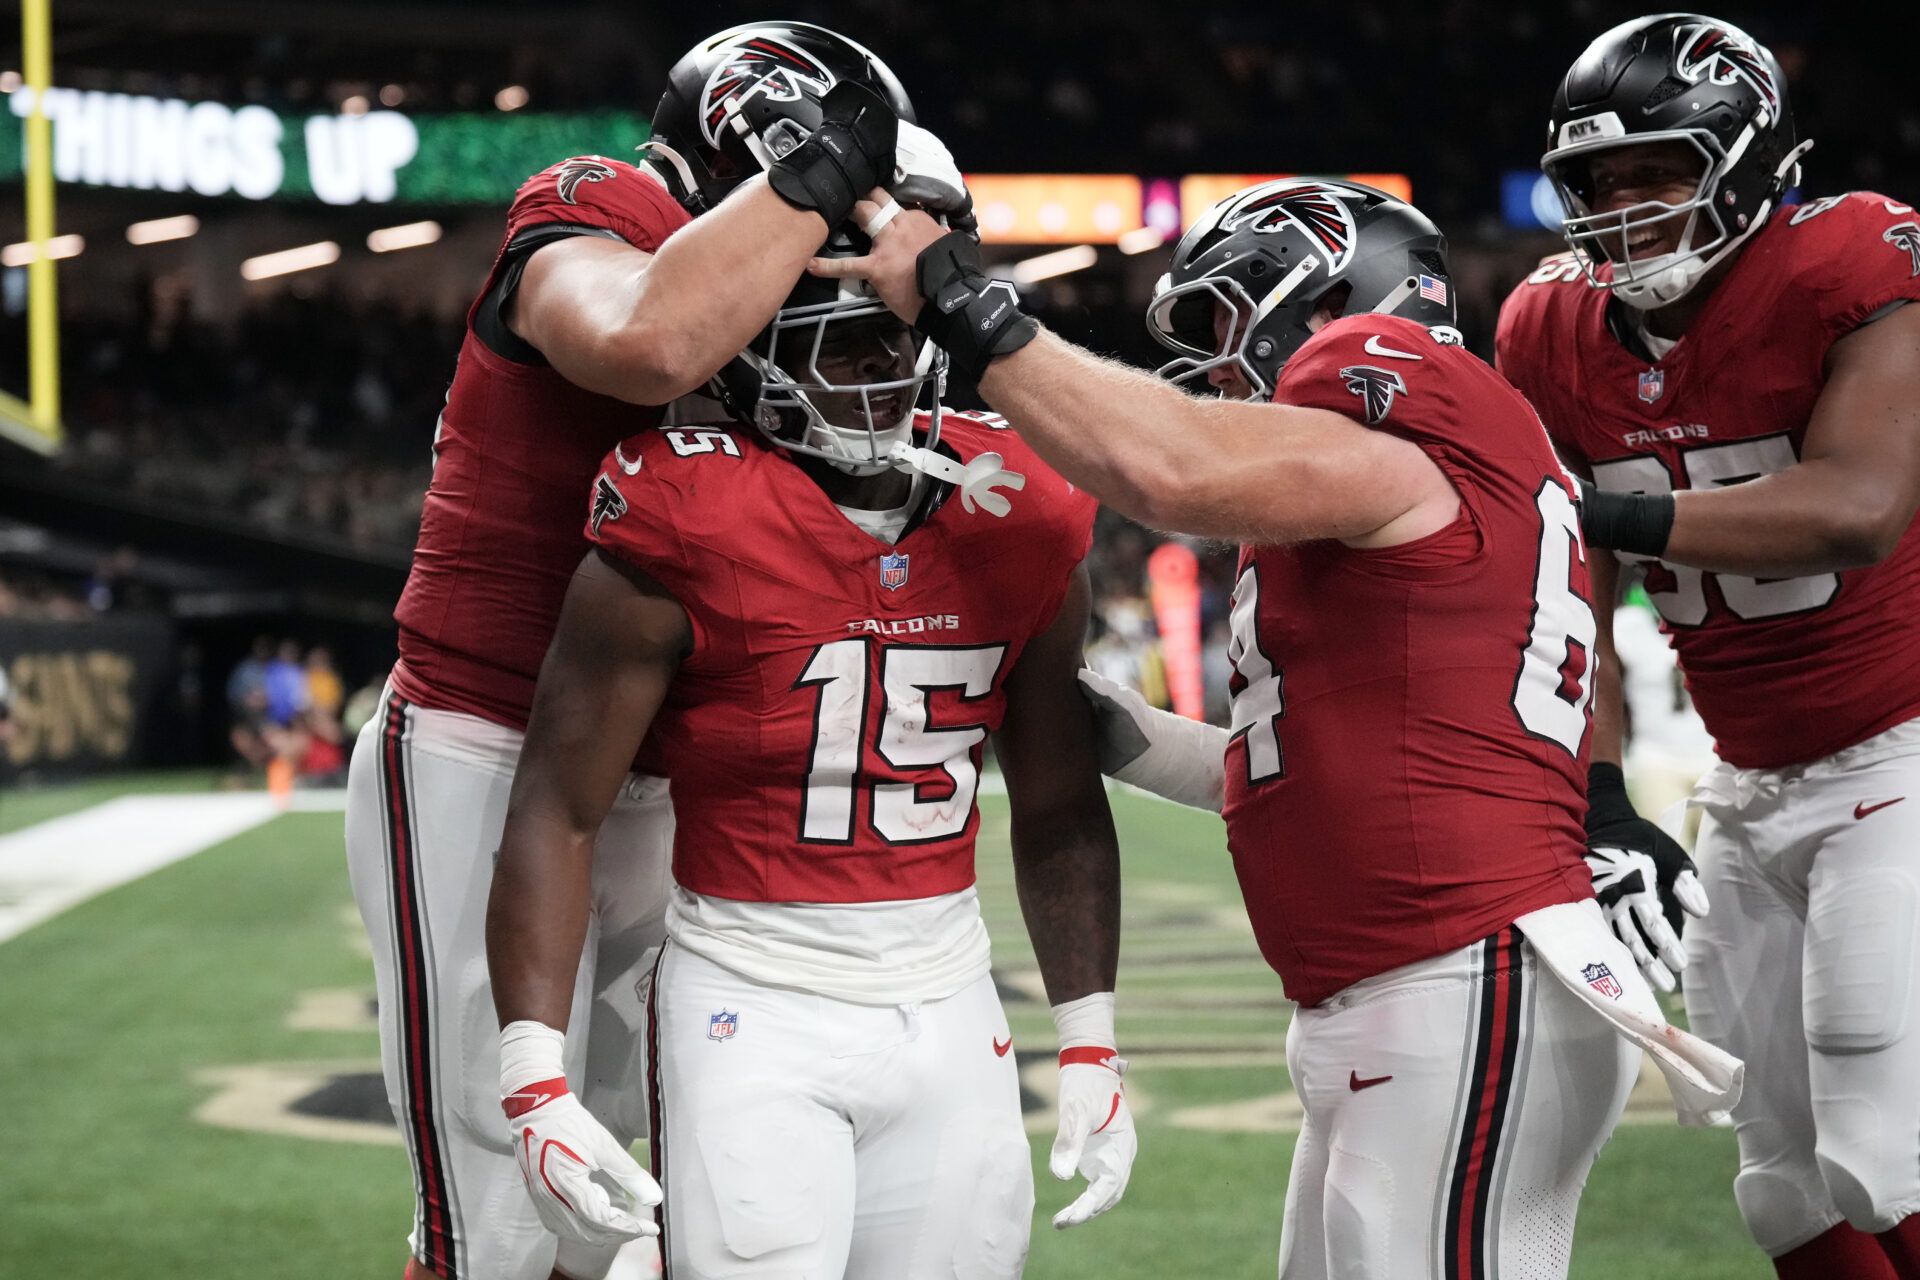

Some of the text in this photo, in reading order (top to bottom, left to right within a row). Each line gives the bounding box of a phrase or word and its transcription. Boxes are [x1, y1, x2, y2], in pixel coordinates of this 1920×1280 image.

[303, 110, 419, 204] UP
[1567, 119, 1602, 143] ATL
[847, 615, 960, 635] FALCONS
[790, 635, 1011, 847] 15
